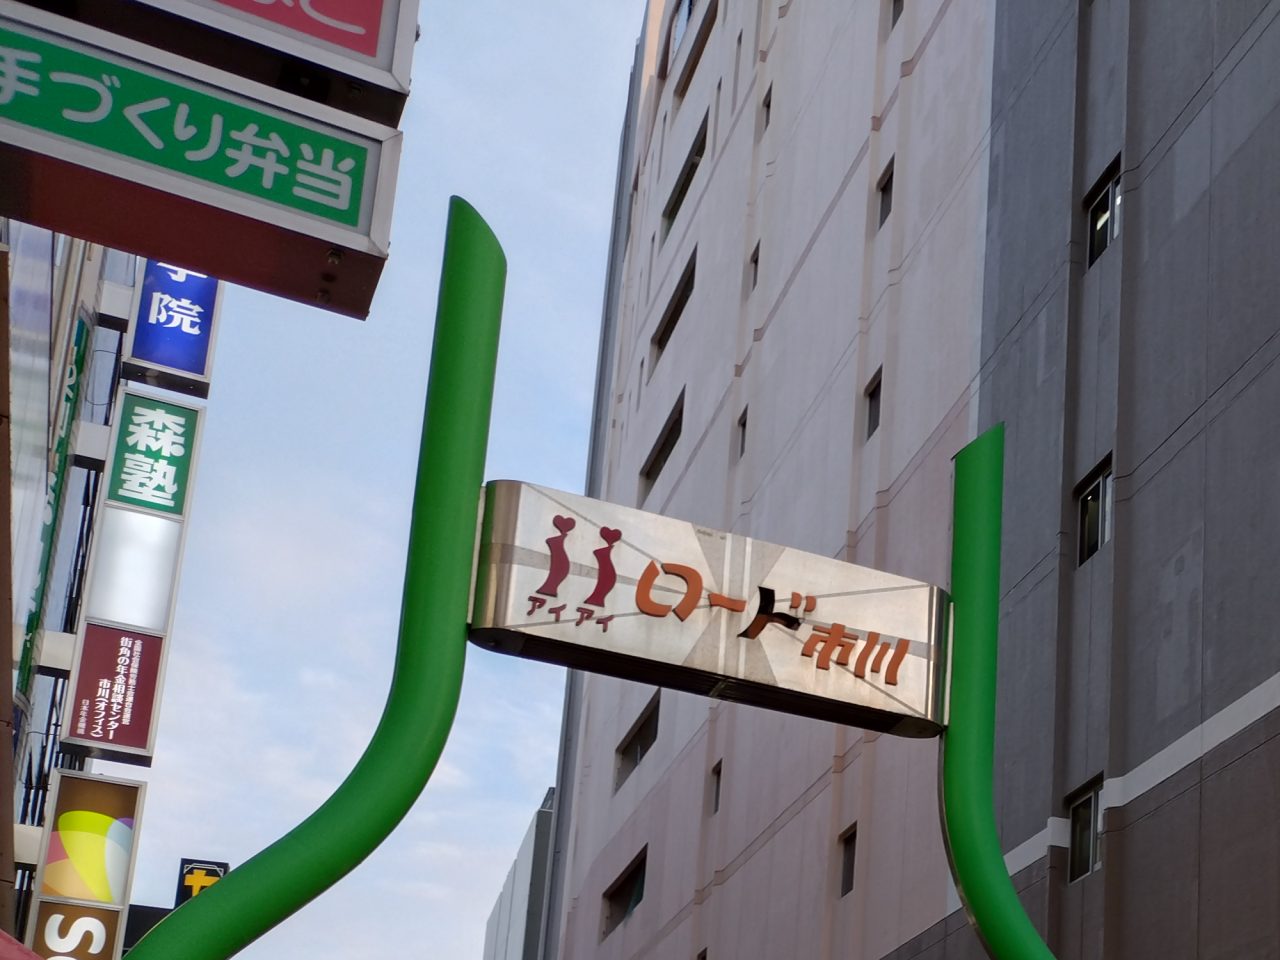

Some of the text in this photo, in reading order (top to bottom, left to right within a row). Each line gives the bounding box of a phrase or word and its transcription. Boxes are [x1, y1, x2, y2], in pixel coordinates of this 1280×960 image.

[0, 47, 356, 210] 手づくり弁当
[118, 405, 186, 507] 森塾
[527, 596, 615, 633] アイアイ
